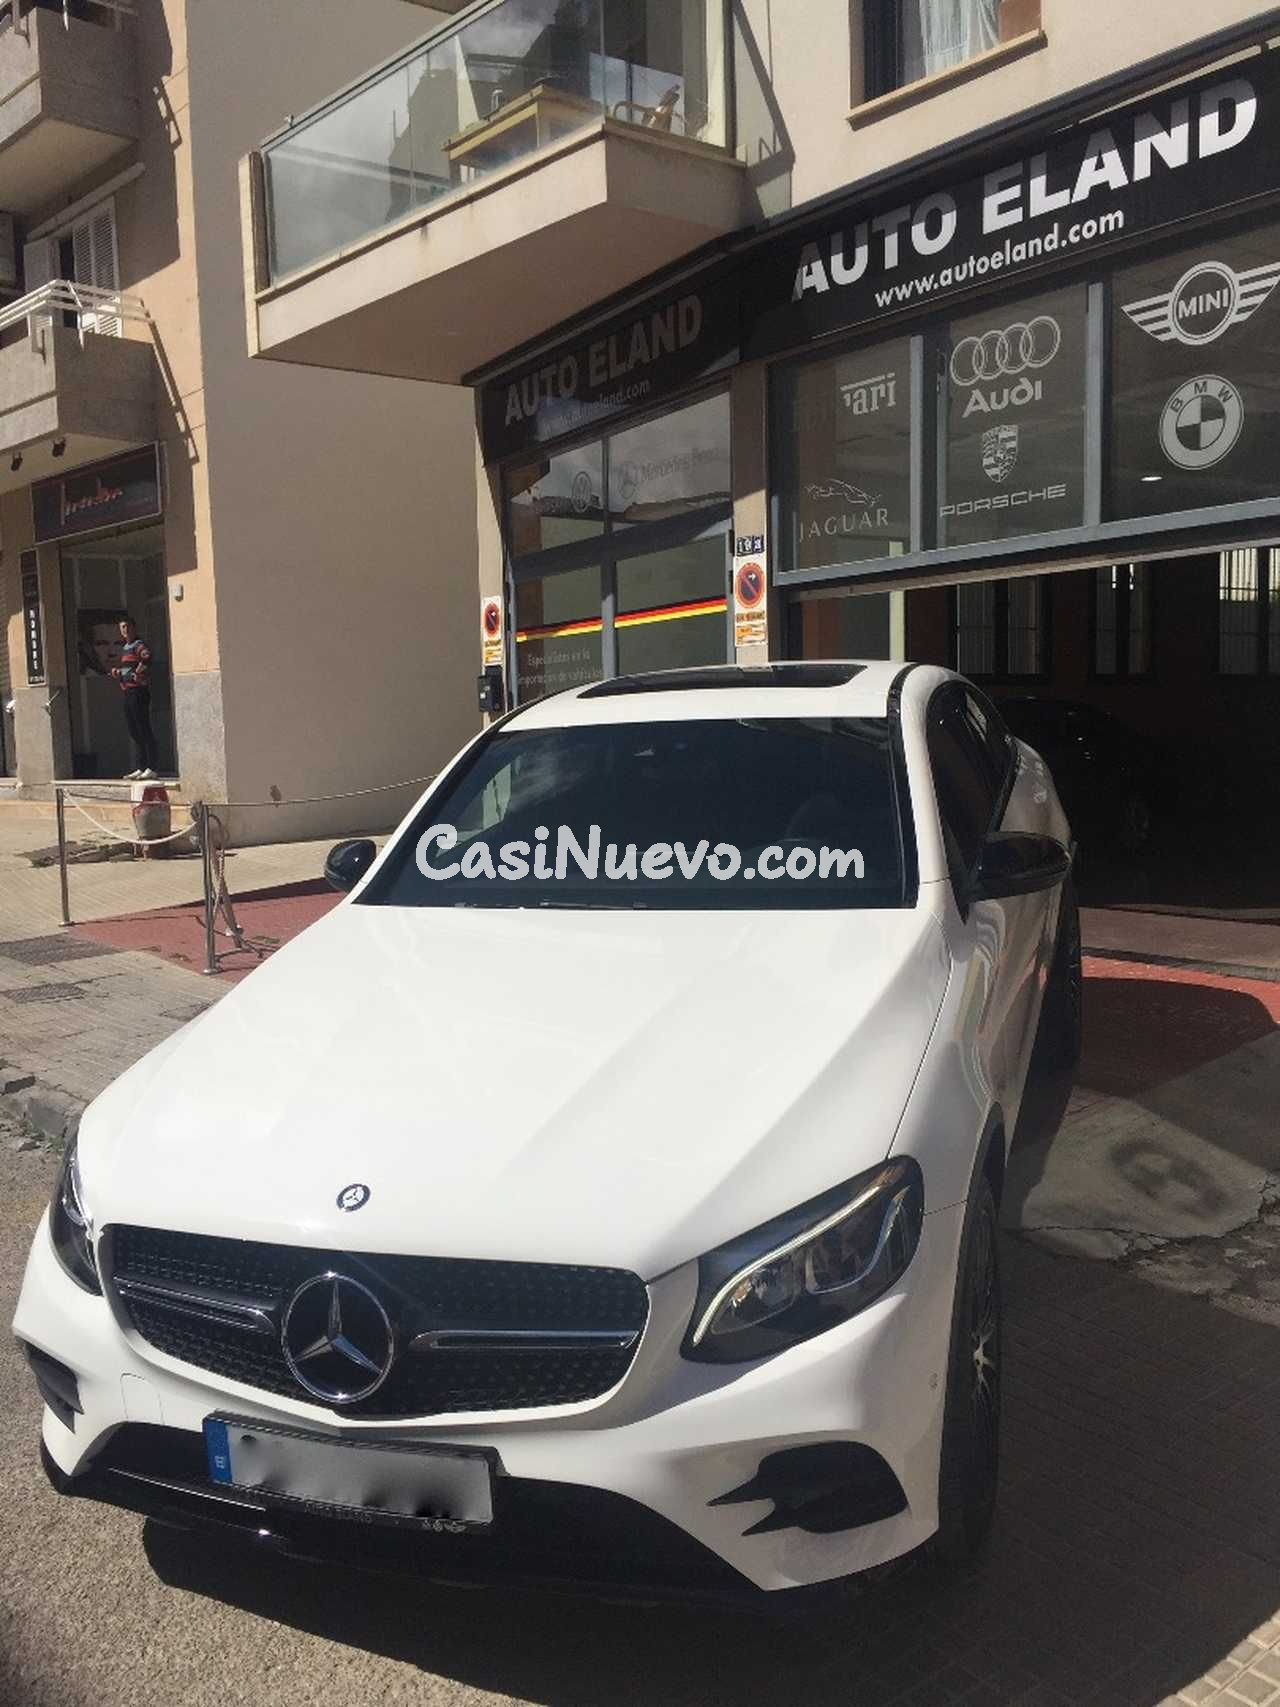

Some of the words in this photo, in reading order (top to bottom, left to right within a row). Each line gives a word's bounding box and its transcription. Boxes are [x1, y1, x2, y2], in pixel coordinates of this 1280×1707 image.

[791, 194, 958, 303] AUTO
[982, 77, 1258, 234] ELAND
[875, 206, 1124, 308] www.autoeland.com
[1178, 286, 1229, 319] MINI
[505, 355, 578, 426] AUTO
[589, 295, 702, 387] ELAND
[961, 377, 1043, 418] Audi
[1169, 380, 1233, 413] BMW
[939, 484, 1067, 517] PORSCHE
[799, 508, 889, 543] JAGUAR
